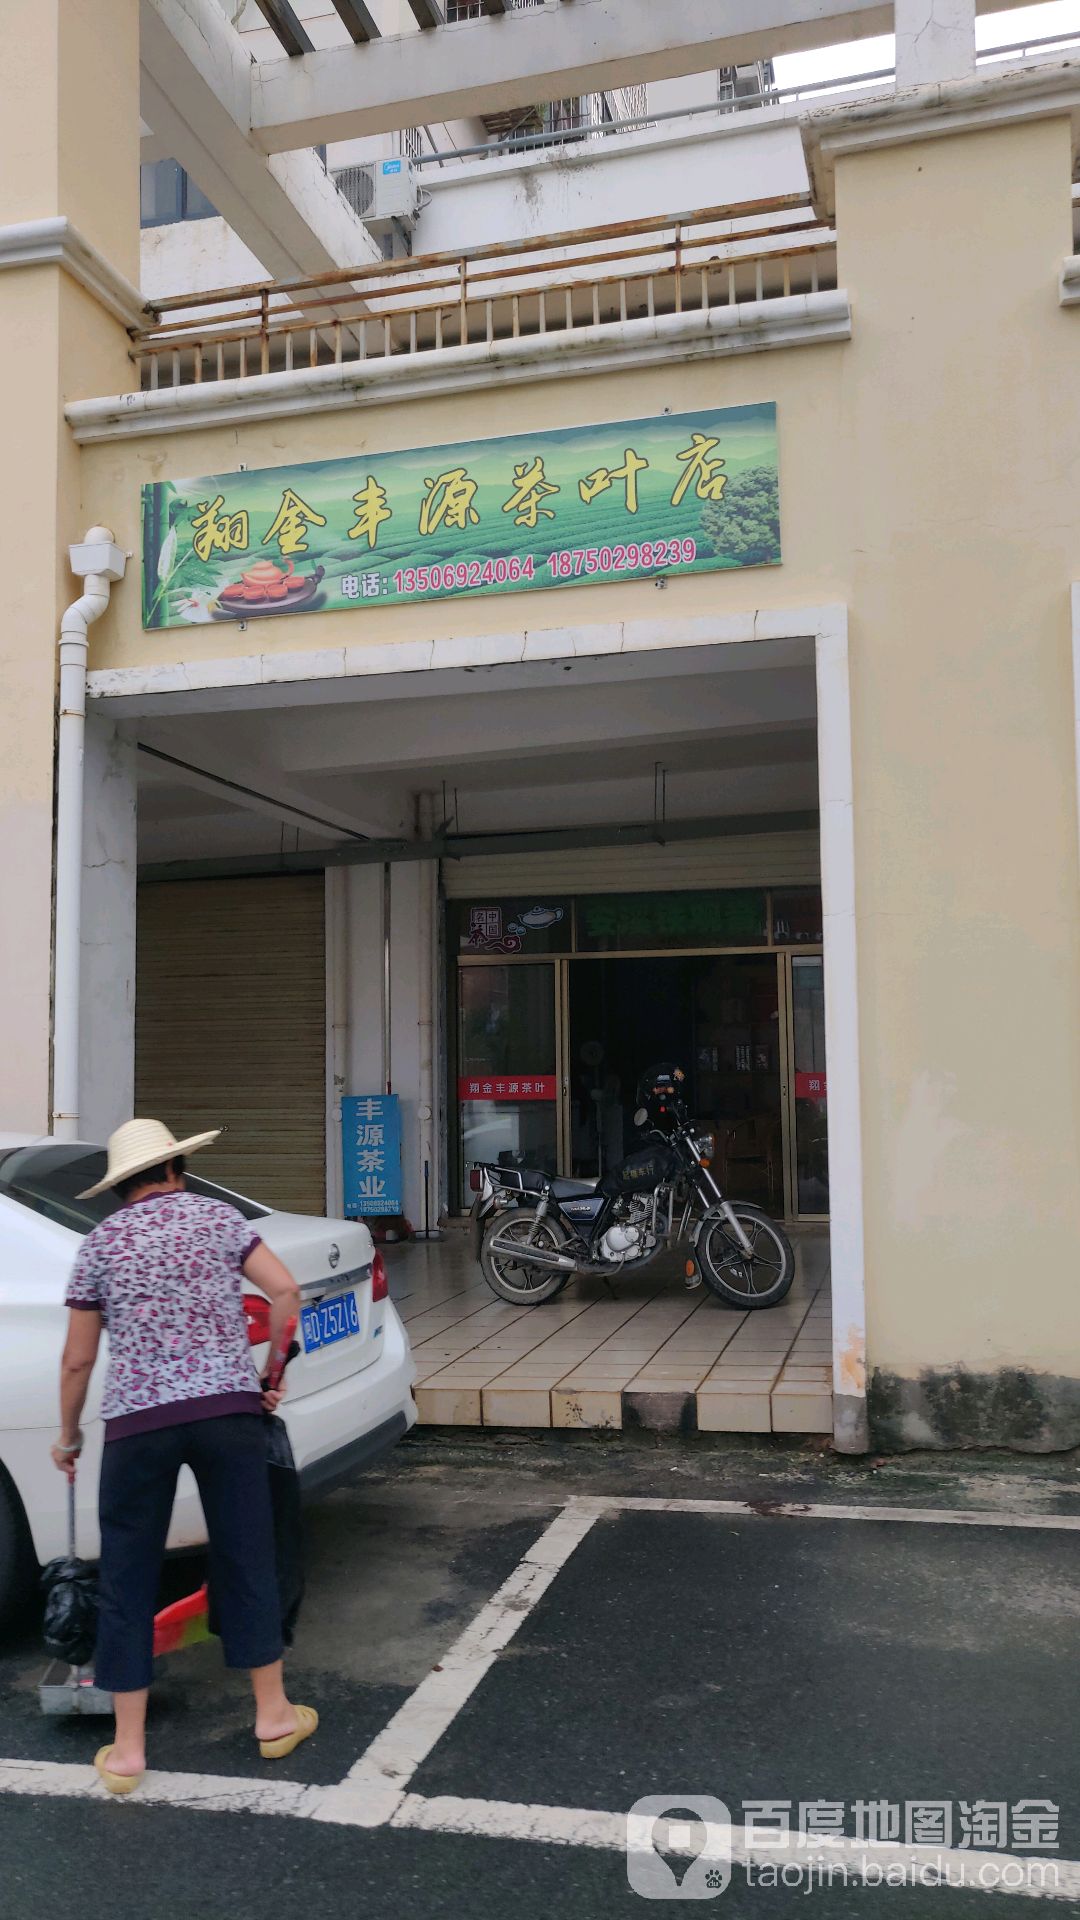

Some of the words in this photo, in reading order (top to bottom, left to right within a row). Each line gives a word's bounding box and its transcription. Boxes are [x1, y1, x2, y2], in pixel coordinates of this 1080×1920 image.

[192, 433, 728, 562] 翔金丰源茶叶店
[393, 554, 534, 594] 13506924064
[547, 537, 697, 577] 18750298239
[469, 1082, 545, 1094] 翔金丰源茶叶
[355, 1098, 386, 1198] 丰源茶业
